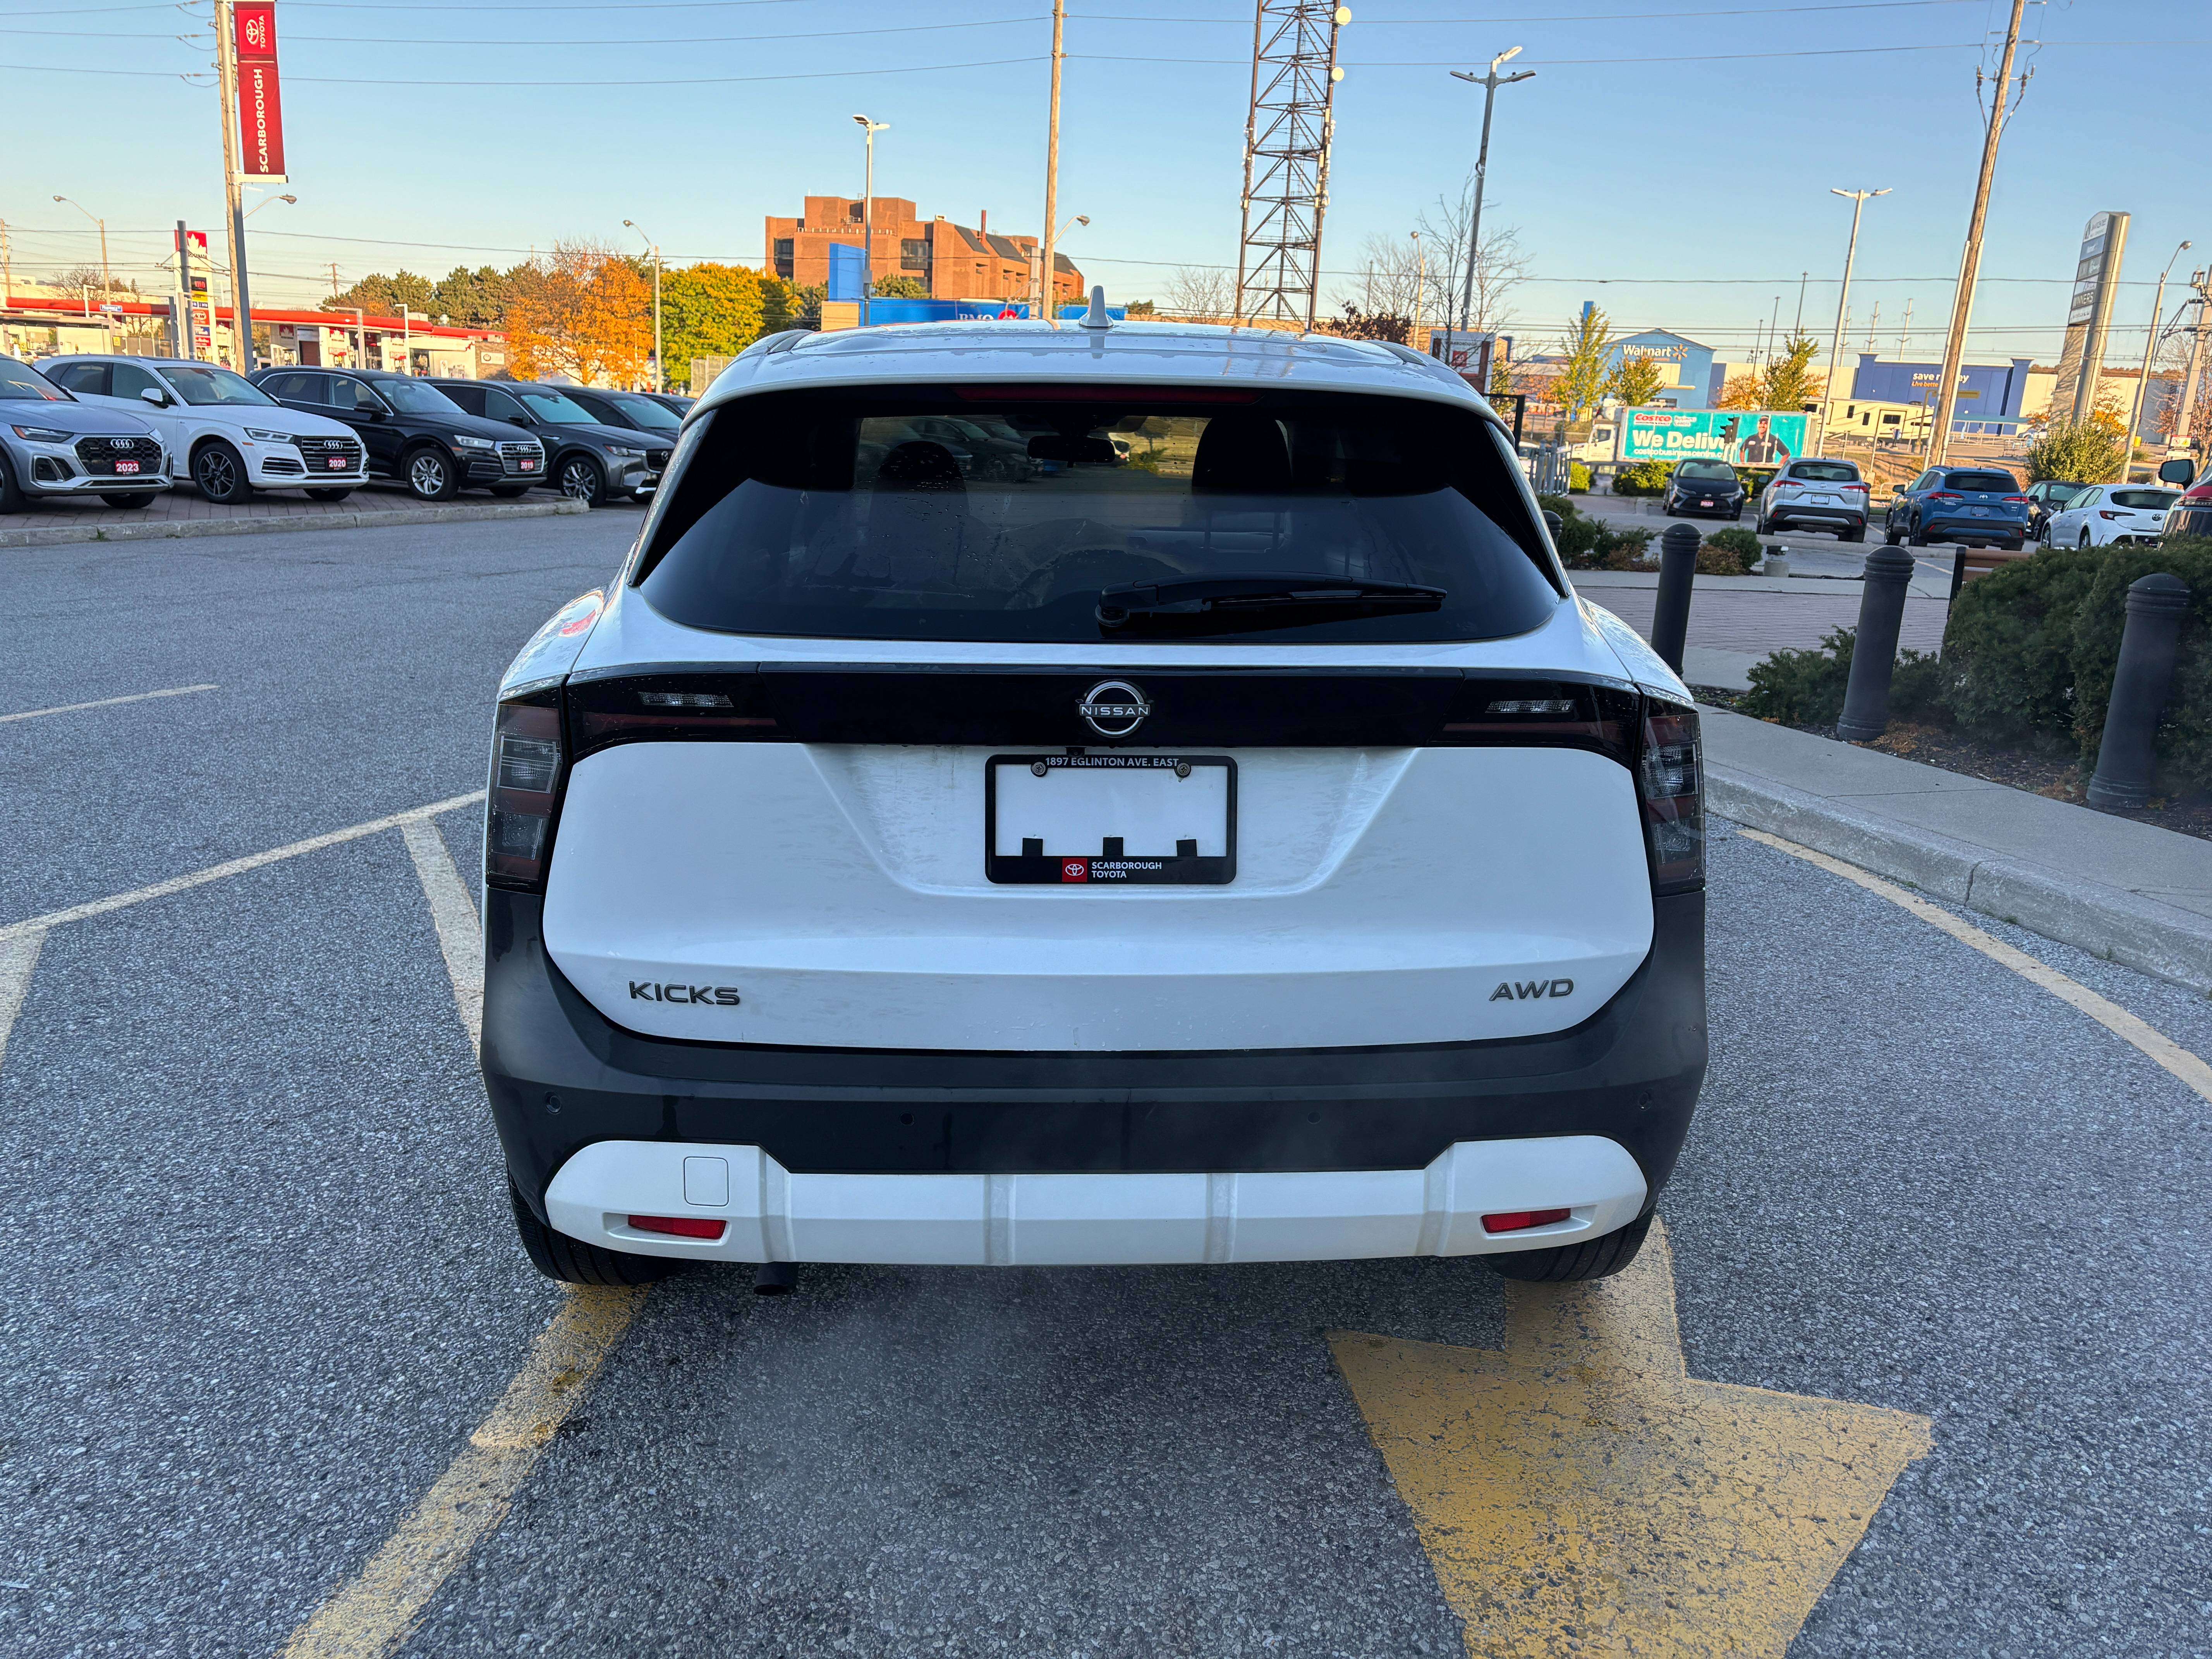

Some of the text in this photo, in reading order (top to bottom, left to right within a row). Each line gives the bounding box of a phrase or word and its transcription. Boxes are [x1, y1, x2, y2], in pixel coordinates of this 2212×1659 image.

[254, 69, 269, 173] SCARBOROUGH
[1623, 344, 1671, 357] Walmart
[1632, 430, 1664, 447] We
[116, 463, 139, 472] 2023
[329, 459, 346, 467] 2020
[1081, 706, 1149, 716] NISSAN
[1046, 757, 1179, 767] 1897 EGLINTON AVE. EAST
[629, 981, 740, 1005] KICKS
[1489, 978, 1574, 1001] AWD
